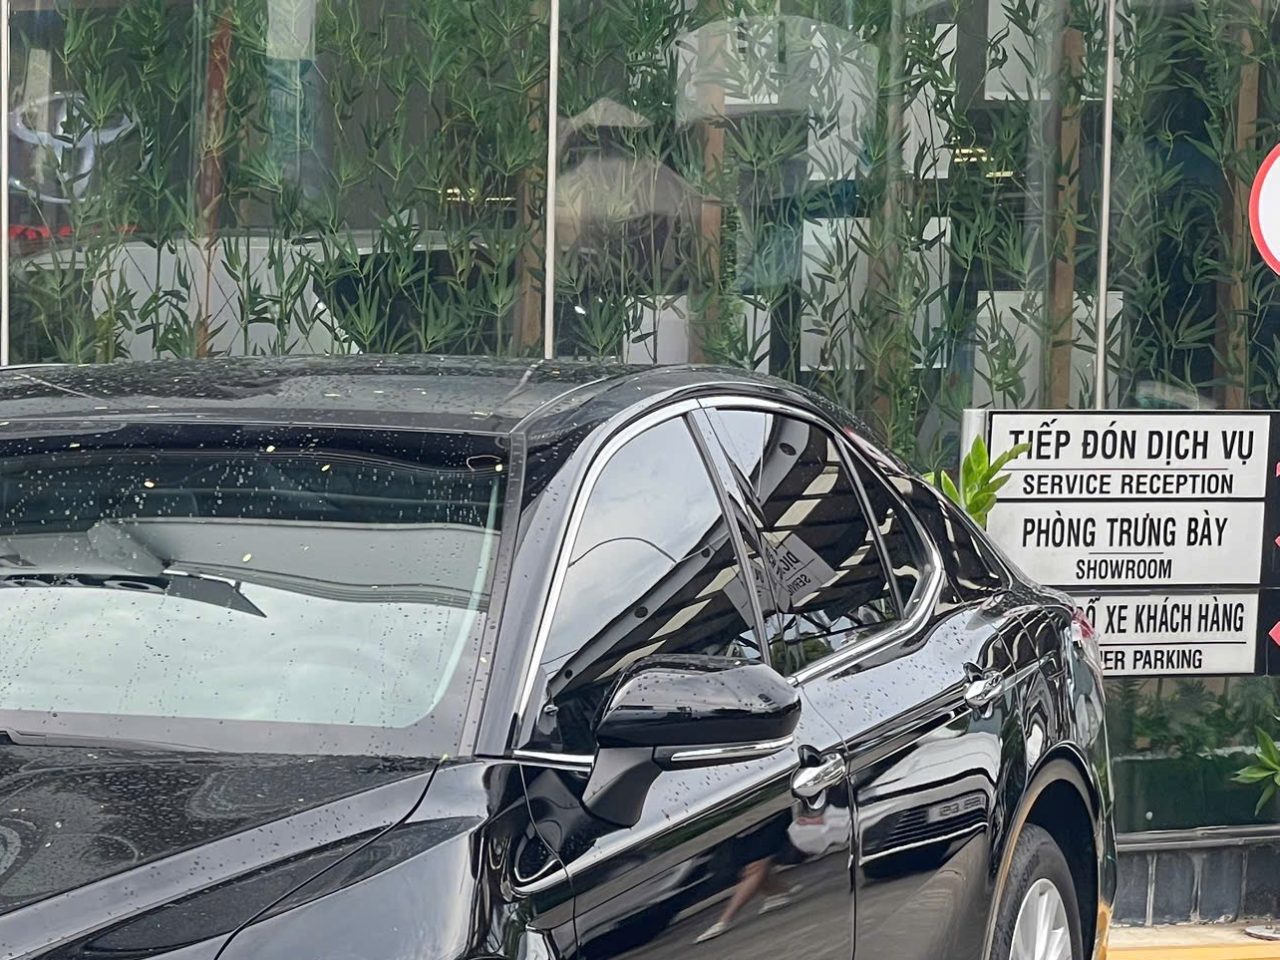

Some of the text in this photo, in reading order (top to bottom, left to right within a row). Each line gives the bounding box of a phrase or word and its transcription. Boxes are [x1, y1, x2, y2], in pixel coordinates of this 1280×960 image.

[1009, 418, 1254, 466] TIẾP ĐÓN DỊCH VỤ
[1023, 474, 1234, 495] SERVICE RECEPTION
[1022, 510, 1228, 547] PHÒNG TRƯNG BÀY
[1076, 559, 1172, 580] SHOWROOM
[1077, 596, 1244, 634] Ỗ XE KHÁCH HÀNG
[1100, 650, 1203, 670] ER PARKING
